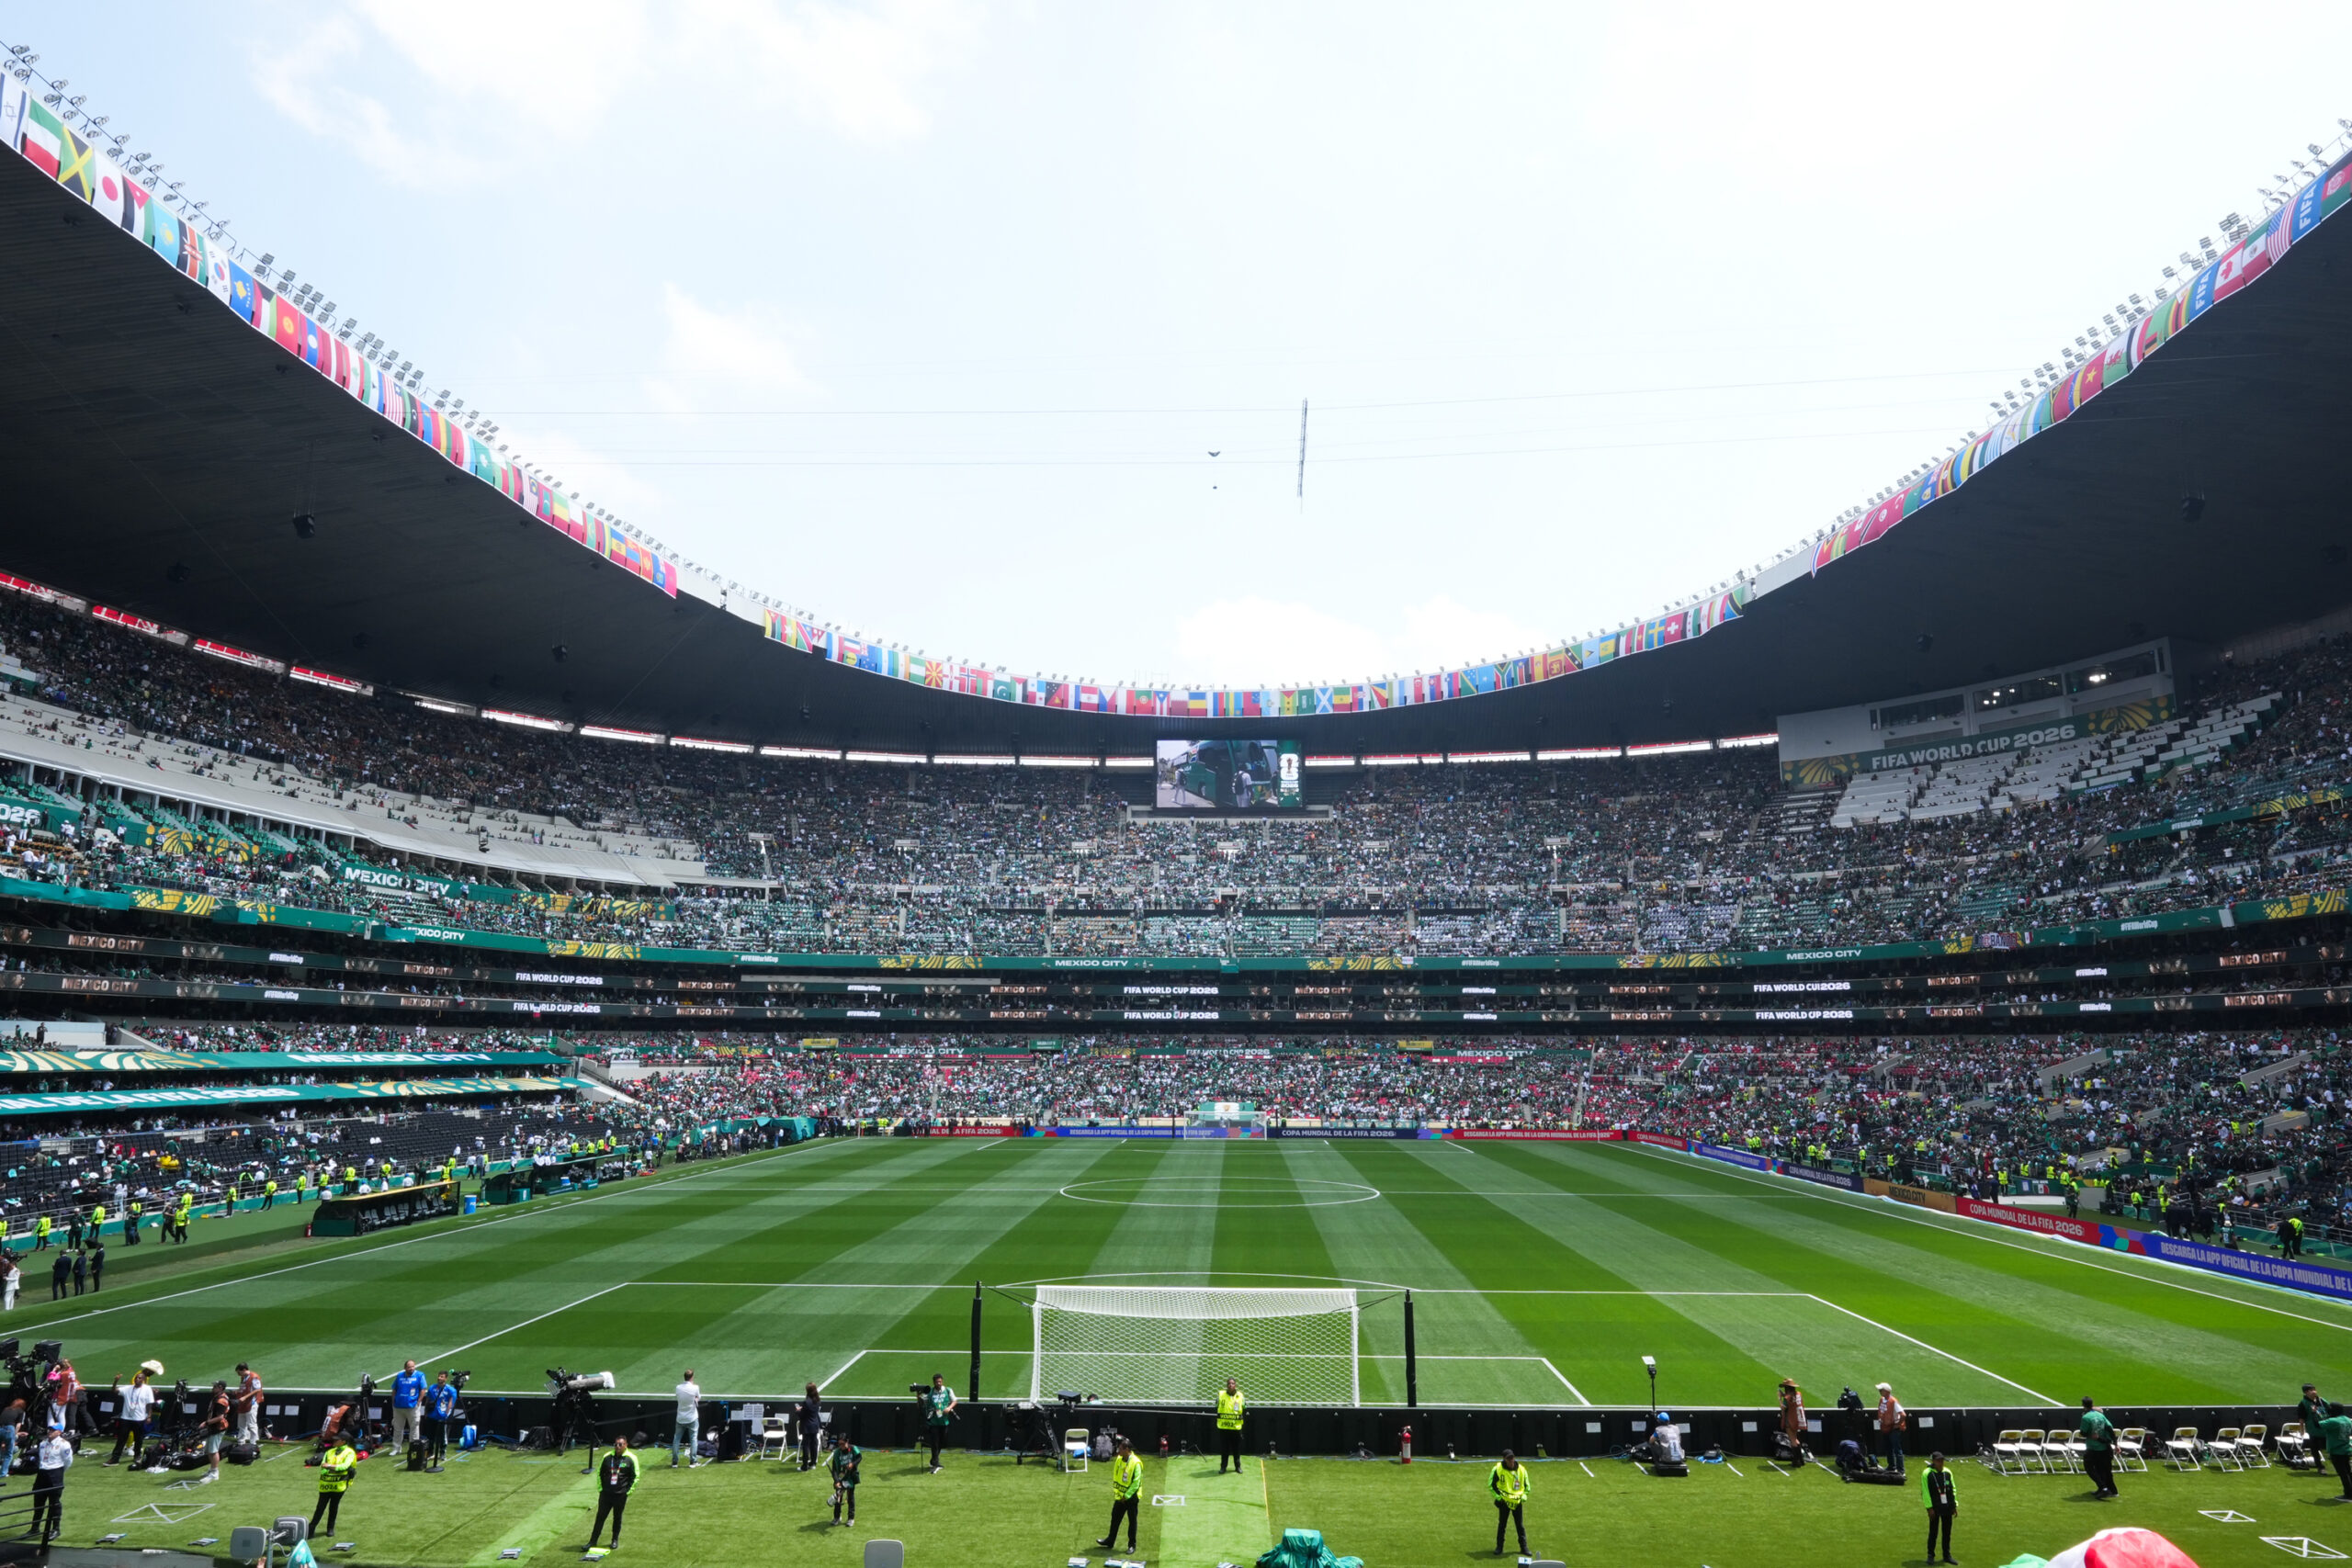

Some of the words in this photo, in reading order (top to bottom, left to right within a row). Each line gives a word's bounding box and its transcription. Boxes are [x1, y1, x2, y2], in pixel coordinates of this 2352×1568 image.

[2299, 184, 2317, 231] FIFA
[2195, 269, 2211, 310] FIFA
[1871, 752, 1907, 770] FIFA
[1909, 743, 1973, 764] WORLD
[1976, 736, 2010, 754] CUP
[2013, 724, 2076, 749] 2026
[345, 867, 410, 888] MEXICO
[443, 931, 465, 941] CITY
[69, 933, 114, 950] MEXICO
[118, 939, 145, 951] CITY
[1787, 952, 1833, 961] MEXICO
[1835, 950, 1861, 959] CITY
[2220, 953, 2260, 967] MEXICO
[2262, 951, 2287, 964] CITY
[1055, 959, 1100, 967] MEXICO
[1102, 959, 1128, 967] CITY
[404, 964, 434, 976] MEXICO
[435, 967, 453, 976] CITY
[515, 973, 531, 982] FIFA
[532, 973, 559, 983] WORLD
[560, 975, 575, 984] CUP
[575, 976, 603, 985] 2026
[1928, 976, 1961, 986] MEXICO
[1962, 976, 1981, 985] CITY
[62, 977, 109, 991] MEXICO
[111, 981, 140, 993] CITY
[678, 980, 713, 990] MEXICO
[714, 982, 736, 990] CITY
[990, 986, 1025, 994] MEXICO
[1026, 986, 1047, 994] CITY
[1610, 986, 1646, 994] MEXICO
[1648, 986, 1671, 994] CITY
[1754, 984, 1773, 992] FIFA
[1773, 984, 1805, 992] WORLD
[1820, 982, 1850, 991] 2026
[1124, 987, 1141, 995] FIFA
[1142, 987, 1172, 995] WORLD
[1172, 987, 1189, 995] CUP
[1190, 987, 1218, 995] 2026
[1295, 987, 1330, 995] MEXICO
[1331, 987, 1352, 995] CITY
[401, 997, 431, 1007] MEXICO
[432, 998, 450, 1008] CITY
[2224, 994, 2265, 1007] MEXICO
[2267, 993, 2292, 1005] CITY
[514, 1002, 529, 1011] FIFA
[557, 1003, 572, 1012] CUP
[572, 1004, 601, 1013] 2026
[676, 1007, 712, 1016] MEXICO
[713, 1008, 735, 1016] CITY
[989, 1010, 1025, 1019] MEXICO
[1026, 1010, 1047, 1019] CITY
[1124, 1011, 1142, 1020] FIFA
[1142, 1011, 1172, 1020] WORLD
[1190, 1011, 1219, 1020] 2026
[1295, 1011, 1330, 1020] MEXICO
[1332, 1011, 1353, 1020] CITY
[1756, 1011, 1775, 1020] FIFA
[1776, 1011, 1807, 1020] WORLD
[1822, 1010, 1853, 1019] 2026
[287, 1055, 426, 1063] MEXICO
[423, 1053, 492, 1062] CITY
[41, 1096, 103, 1106] DE
[89, 1094, 150, 1104] LA
[131, 1091, 210, 1102] FIFA
[199, 1088, 300, 1099] 2026
[1789, 1167, 1798, 1175] COPA
[1798, 1168, 1815, 1179] MUNDIAL
[1821, 1173, 1826, 1181] LA
[1826, 1174, 1836, 1183] FIFA
[1836, 1176, 1851, 1187] 2026
[1889, 1186, 1911, 1201] MEXICO
[1911, 1190, 1926, 1203] CITY
[1970, 1204, 1986, 1215] COPA
[1987, 1207, 2017, 1223] MUNDIAL
[2018, 1214, 2027, 1224] DE
[2028, 1216, 2038, 1227] LA
[2038, 1218, 2053, 1230] FIFA
[2055, 1221, 2083, 1236] 2026
[2161, 1242, 2197, 1261] DESCARGA
[2197, 1249, 2207, 1262] LA
[2207, 1251, 2220, 1266] APP
[2221, 1255, 2250, 1271] OFICIAL
[2250, 1260, 2260, 1274] DE
[2260, 1262, 2271, 1276] LA
[2272, 1264, 2293, 1280] COPA
[2294, 1268, 2335, 1289] MUNDIAL
[2335, 1276, 2346, 1292] DE
